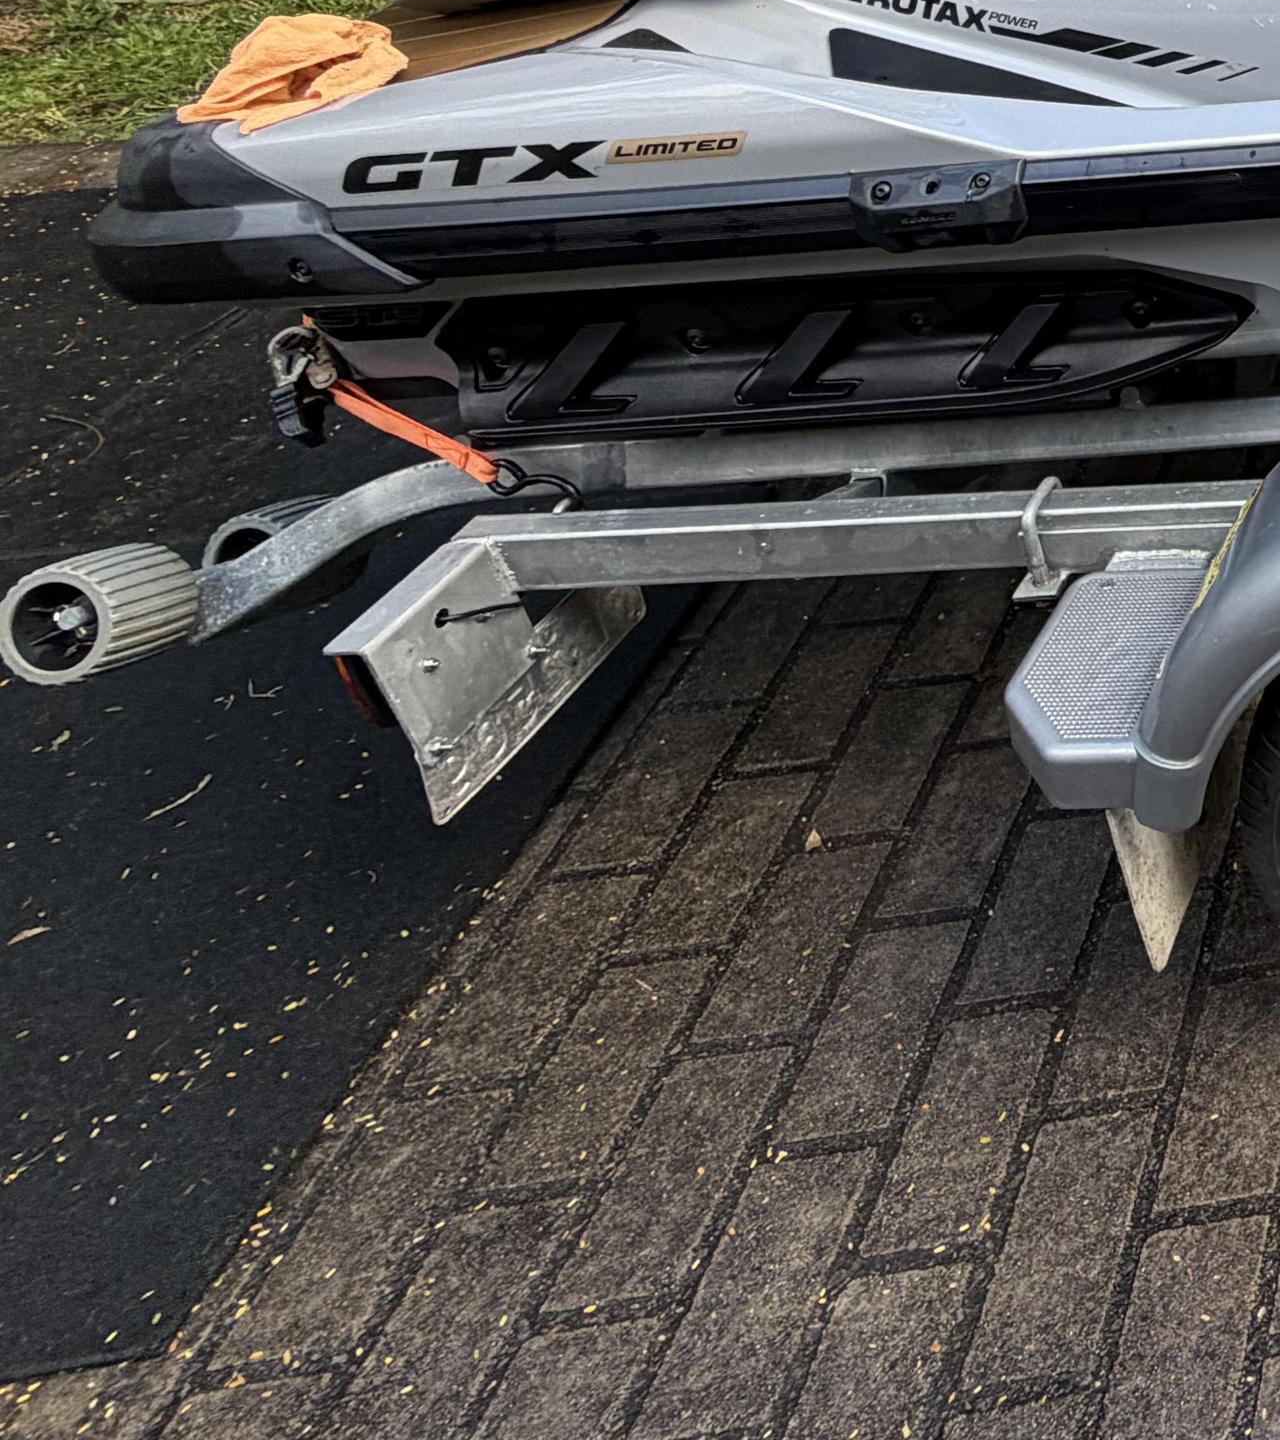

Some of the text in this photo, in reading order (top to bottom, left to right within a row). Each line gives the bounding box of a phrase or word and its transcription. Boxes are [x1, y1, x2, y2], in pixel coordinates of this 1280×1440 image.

[988, 10, 1039, 31] POWER
[341, 136, 738, 195] GTX LIMITED
